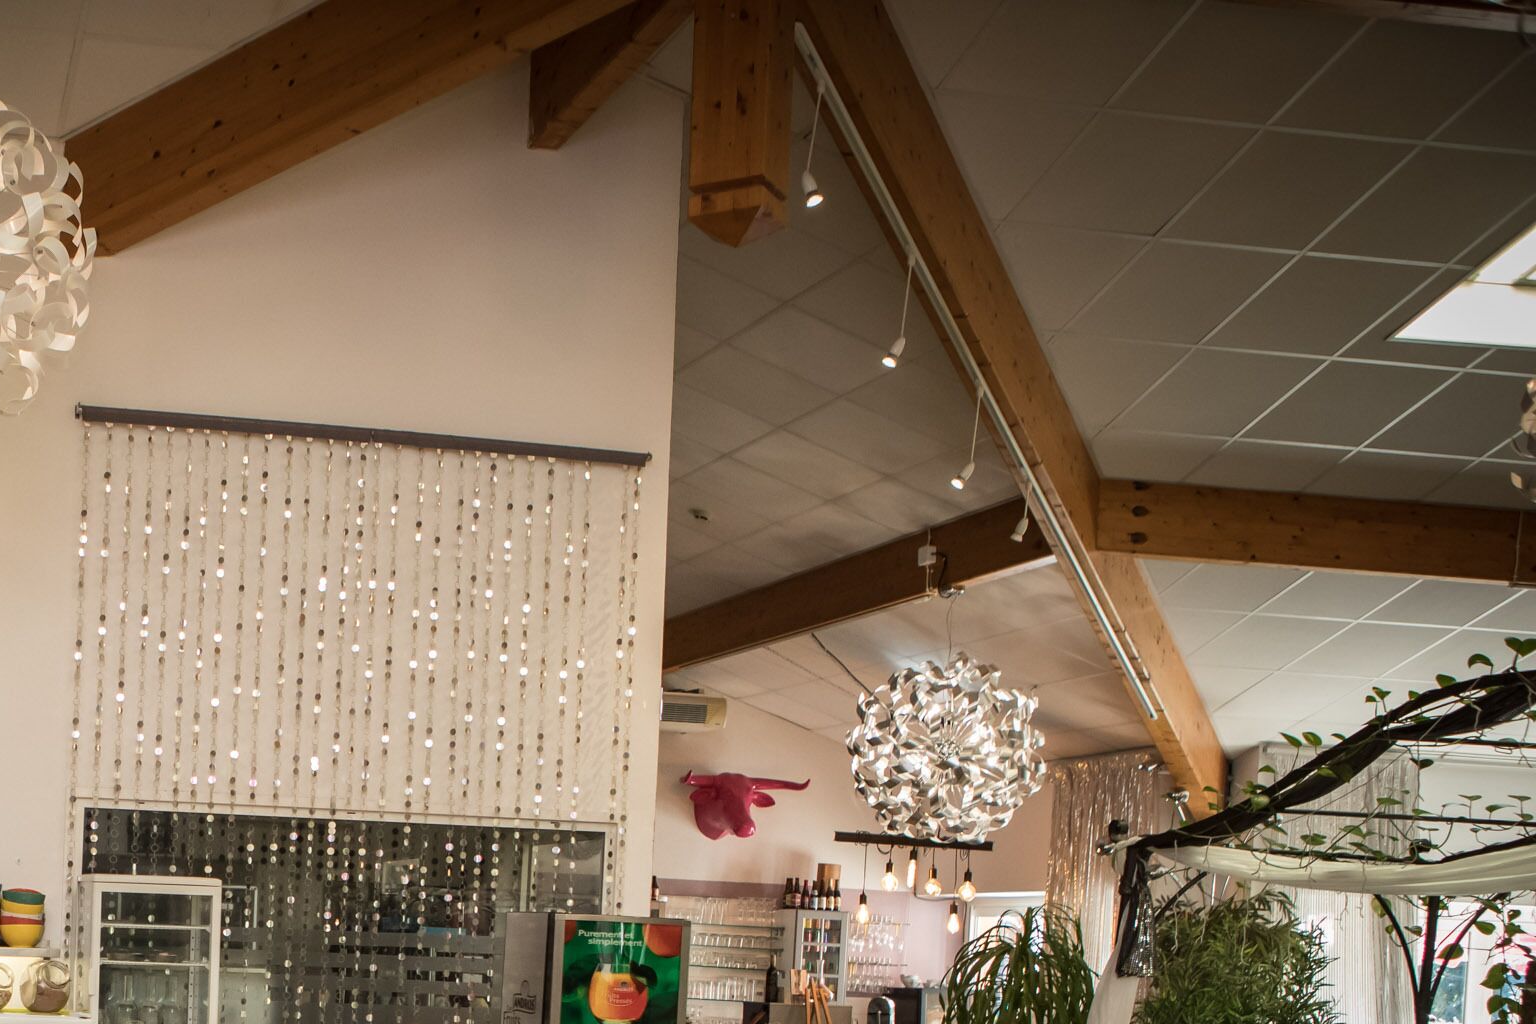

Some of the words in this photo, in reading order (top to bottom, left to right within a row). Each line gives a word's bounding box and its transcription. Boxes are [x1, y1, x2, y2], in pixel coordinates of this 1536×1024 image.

[578, 929, 624, 938] Purement
[588, 938, 643, 947] simplement
[514, 997, 536, 1010] ANDROS
